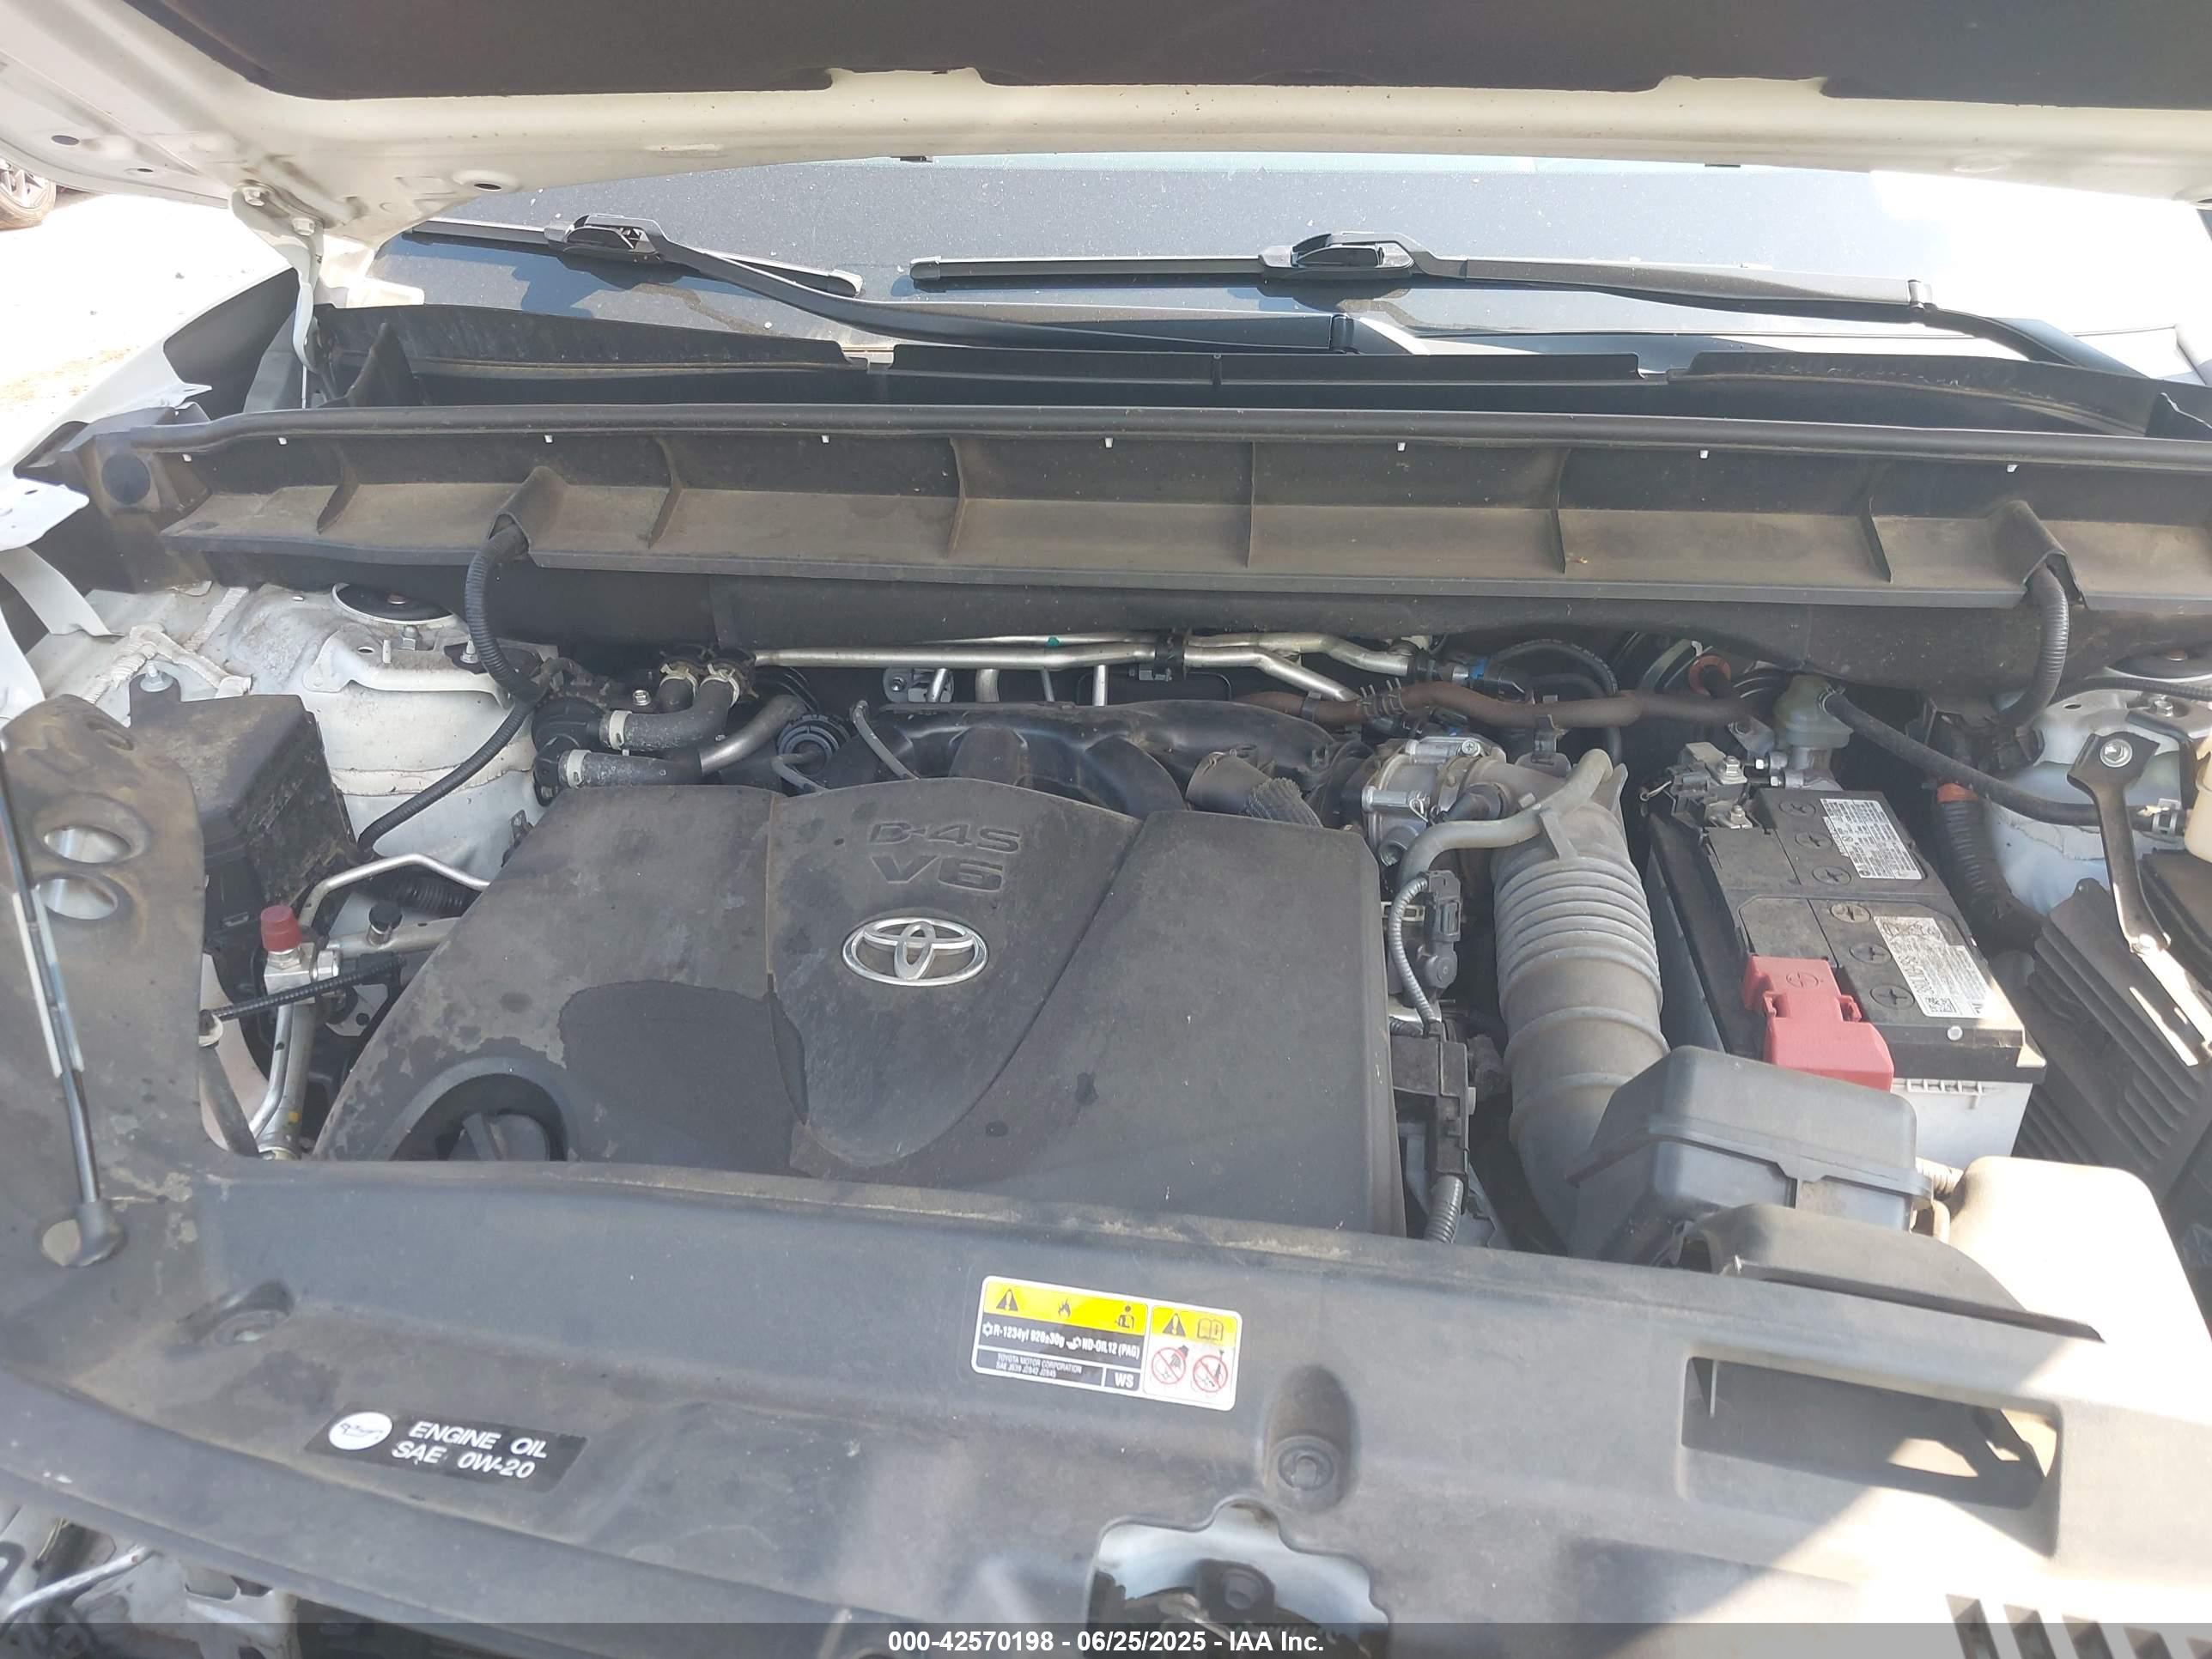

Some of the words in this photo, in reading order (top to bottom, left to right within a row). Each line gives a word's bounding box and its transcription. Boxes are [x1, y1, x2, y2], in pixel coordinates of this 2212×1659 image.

[869, 854, 1004, 893] V6
[997, 1352, 1019, 1364] TOYOTA
[1019, 1355, 1041, 1367] MOTOR
[1041, 1358, 1083, 1374] CORPORATION
[1115, 1371, 1135, 1389] WS
[408, 1420, 501, 1450] ENGINE
[510, 1437, 547, 1459] OIL
[392, 1440, 447, 1463] SAE
[457, 1451, 536, 1480] 0W-20
